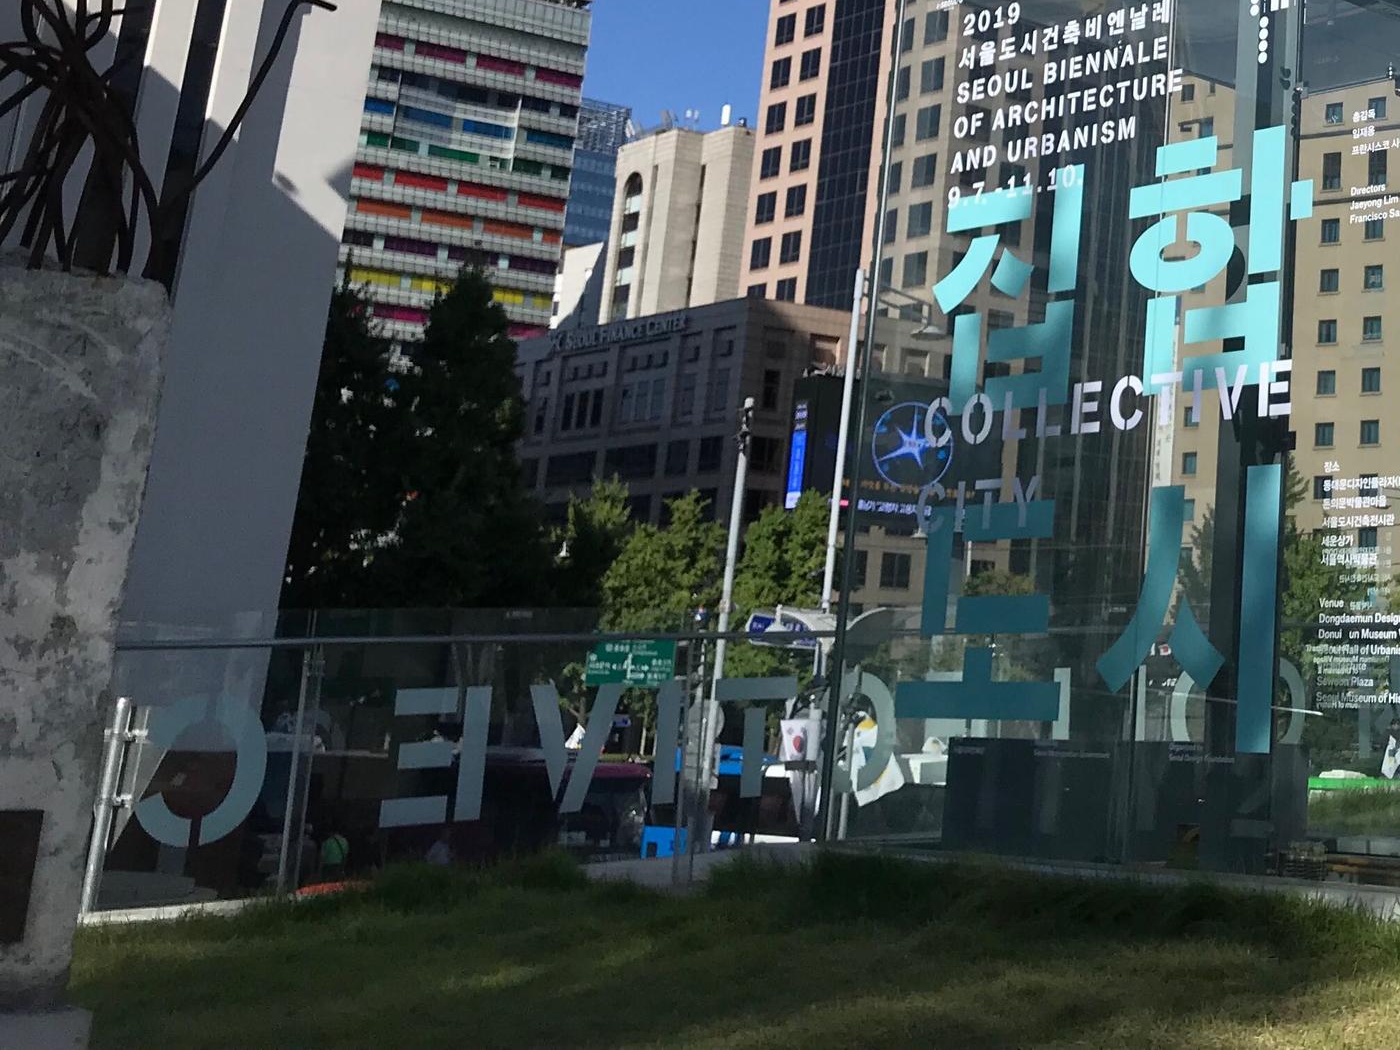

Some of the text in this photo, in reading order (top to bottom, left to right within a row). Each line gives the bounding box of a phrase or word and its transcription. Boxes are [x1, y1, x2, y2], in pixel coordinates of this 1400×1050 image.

[963, 1, 1020, 37] 2019
[956, 35, 1168, 104] SEOUL BIENNALE
[954, 68, 1184, 139] OF ARCHITECTURE
[1352, 108, 1376, 123] 총감독
[949, 115, 1137, 175] AND URBANISM
[1351, 140, 1391, 155] 프란시스코
[1350, 183, 1386, 196] Directors
[1350, 194, 1399, 211] Jaeyong Lim
[1349, 211, 1388, 225] Francisco
[923, 358, 1293, 448] COLLECTIVE
[1324, 461, 1340, 473] 장소
[1319, 598, 1344, 608] Venue
[1319, 613, 1373, 626] Dongdaemun
[1361, 629, 1397, 639] Museum
[1360, 644, 1369, 655] of
[1350, 676, 1374, 687] Plaza
[1378, 692, 1387, 703] of
